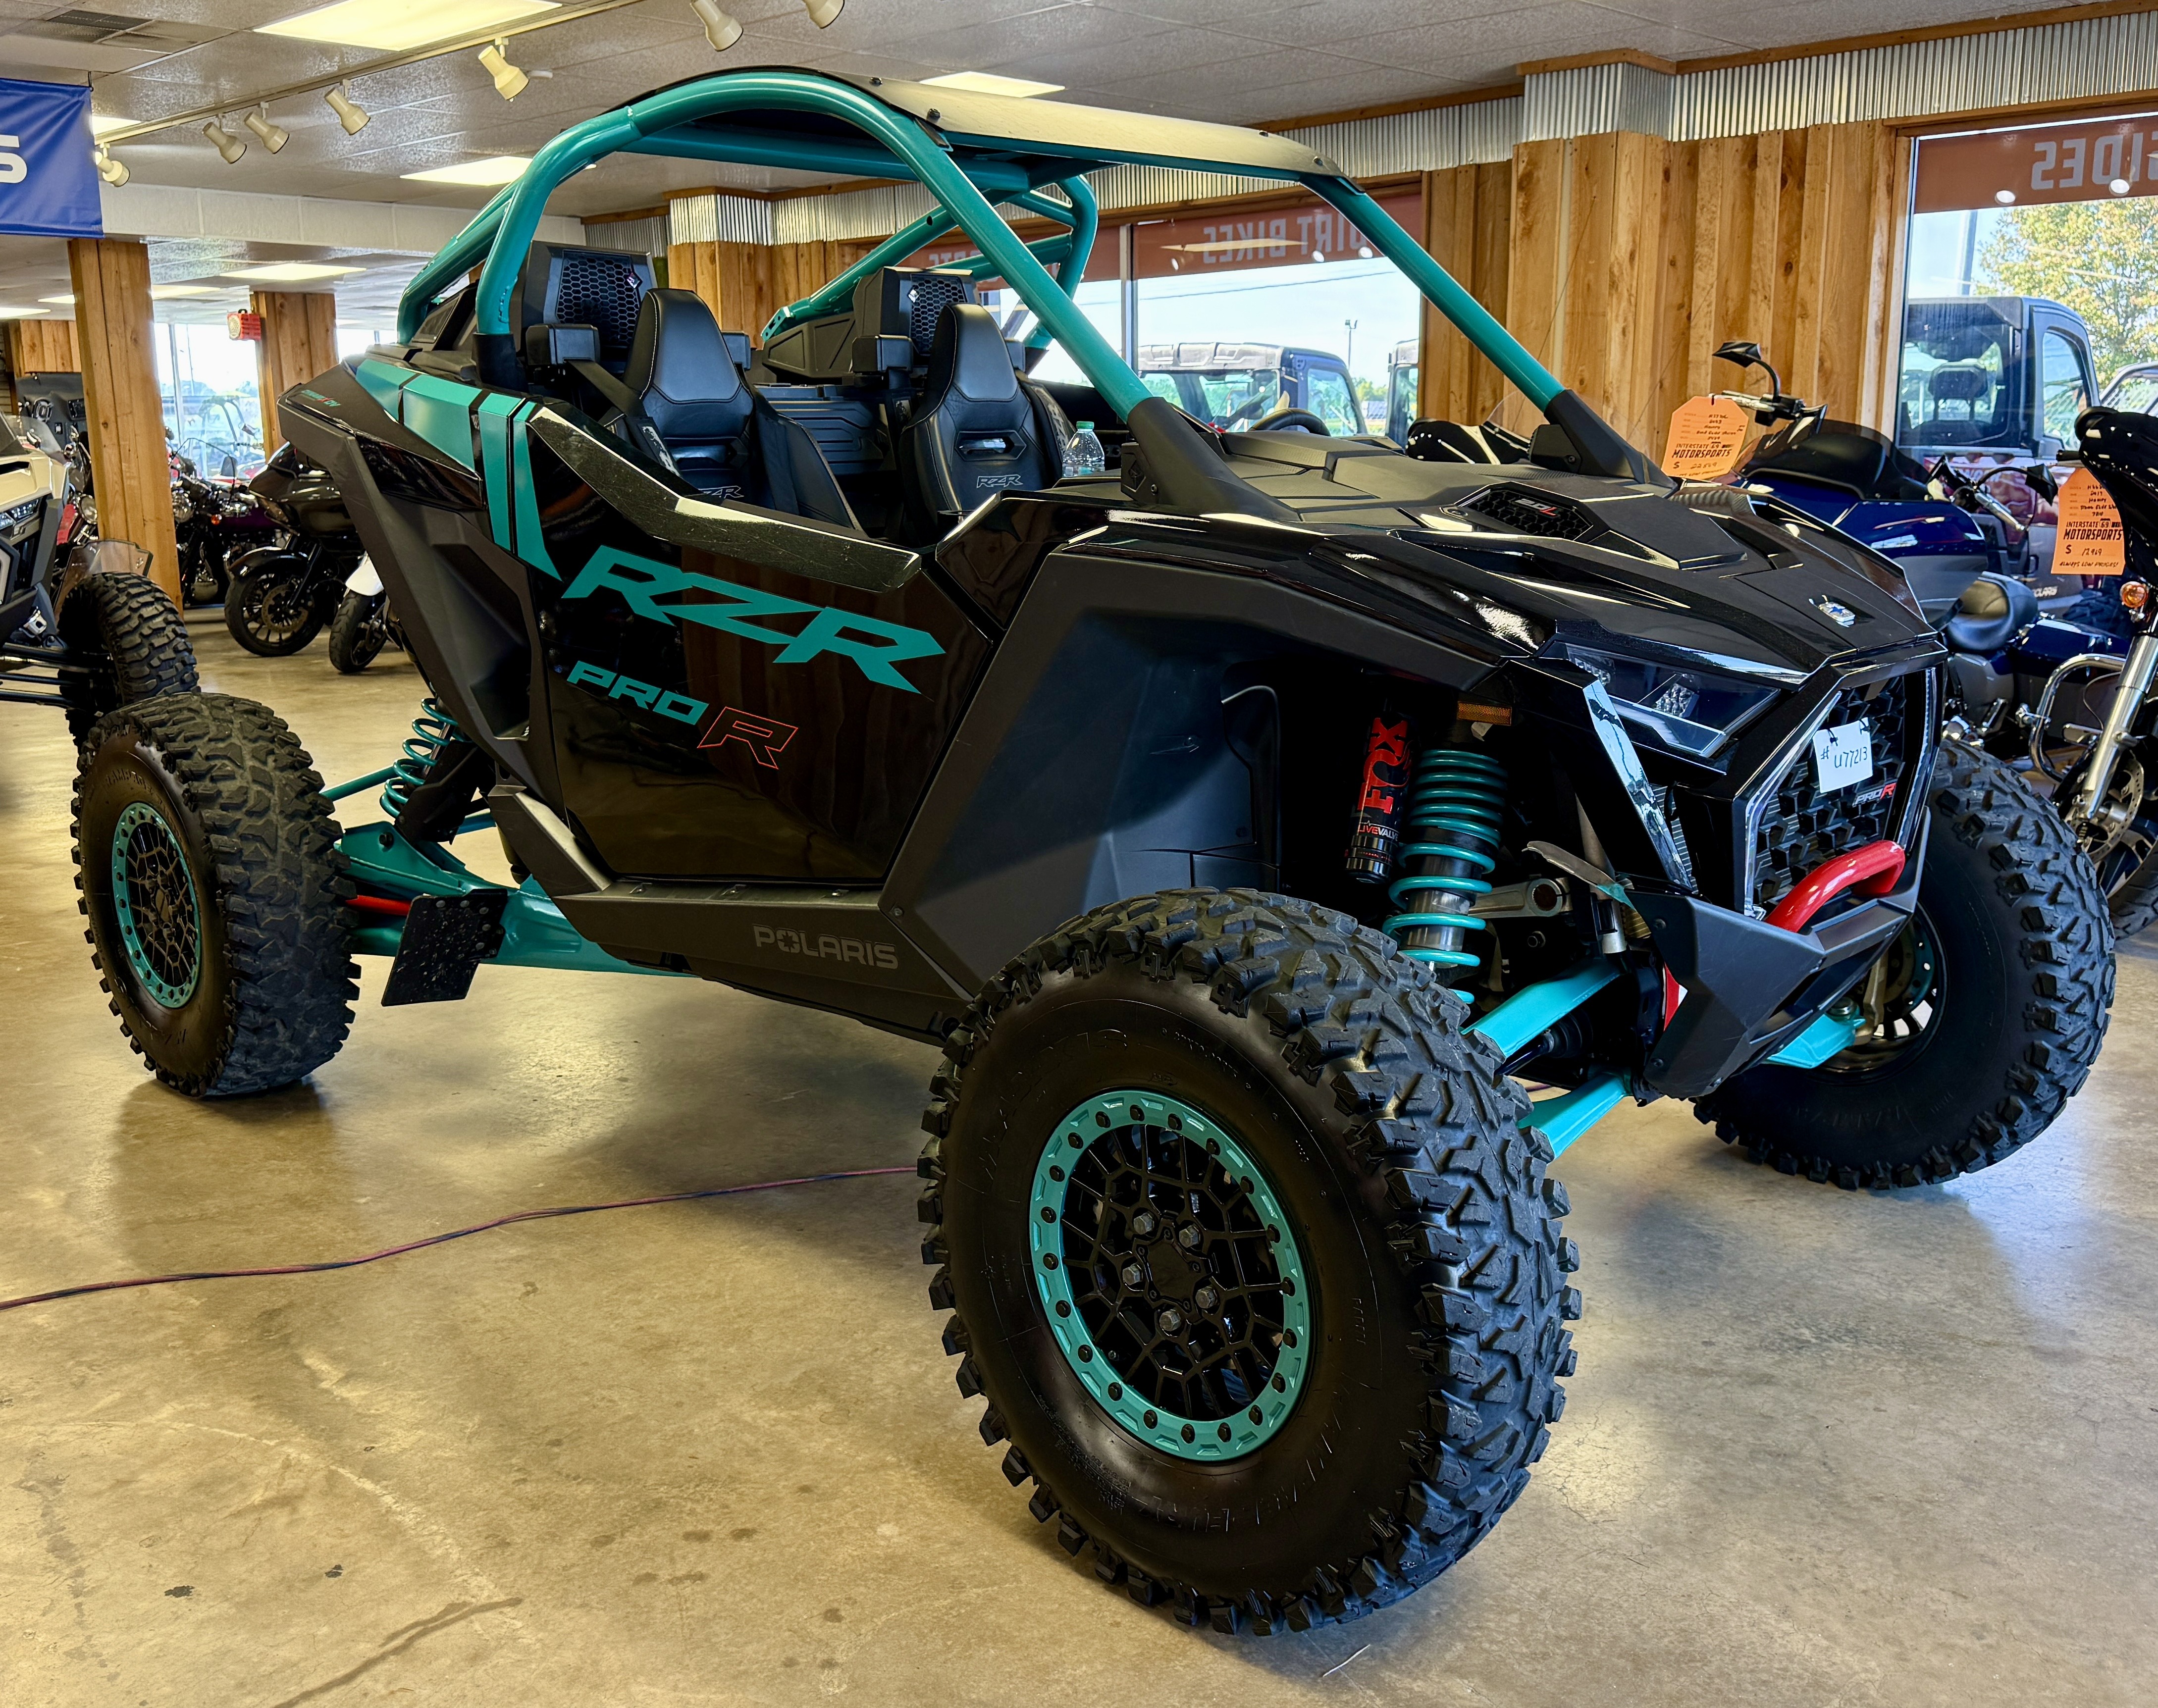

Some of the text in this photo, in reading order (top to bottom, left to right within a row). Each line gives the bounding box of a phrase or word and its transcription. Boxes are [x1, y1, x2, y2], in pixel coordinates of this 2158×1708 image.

[1672, 449, 1733, 458] MOTORSPORTS
[976, 474, 1024, 488] RZR
[698, 485, 745, 499] ZR
[2063, 528, 2124, 541] MOTORSPORTS
[561, 544, 947, 694] RZR
[566, 661, 798, 770] PRO R
[1357, 717, 1412, 815] FOX
[1854, 788, 1882, 805] PRO
[755, 925, 898, 970] POLARIS
